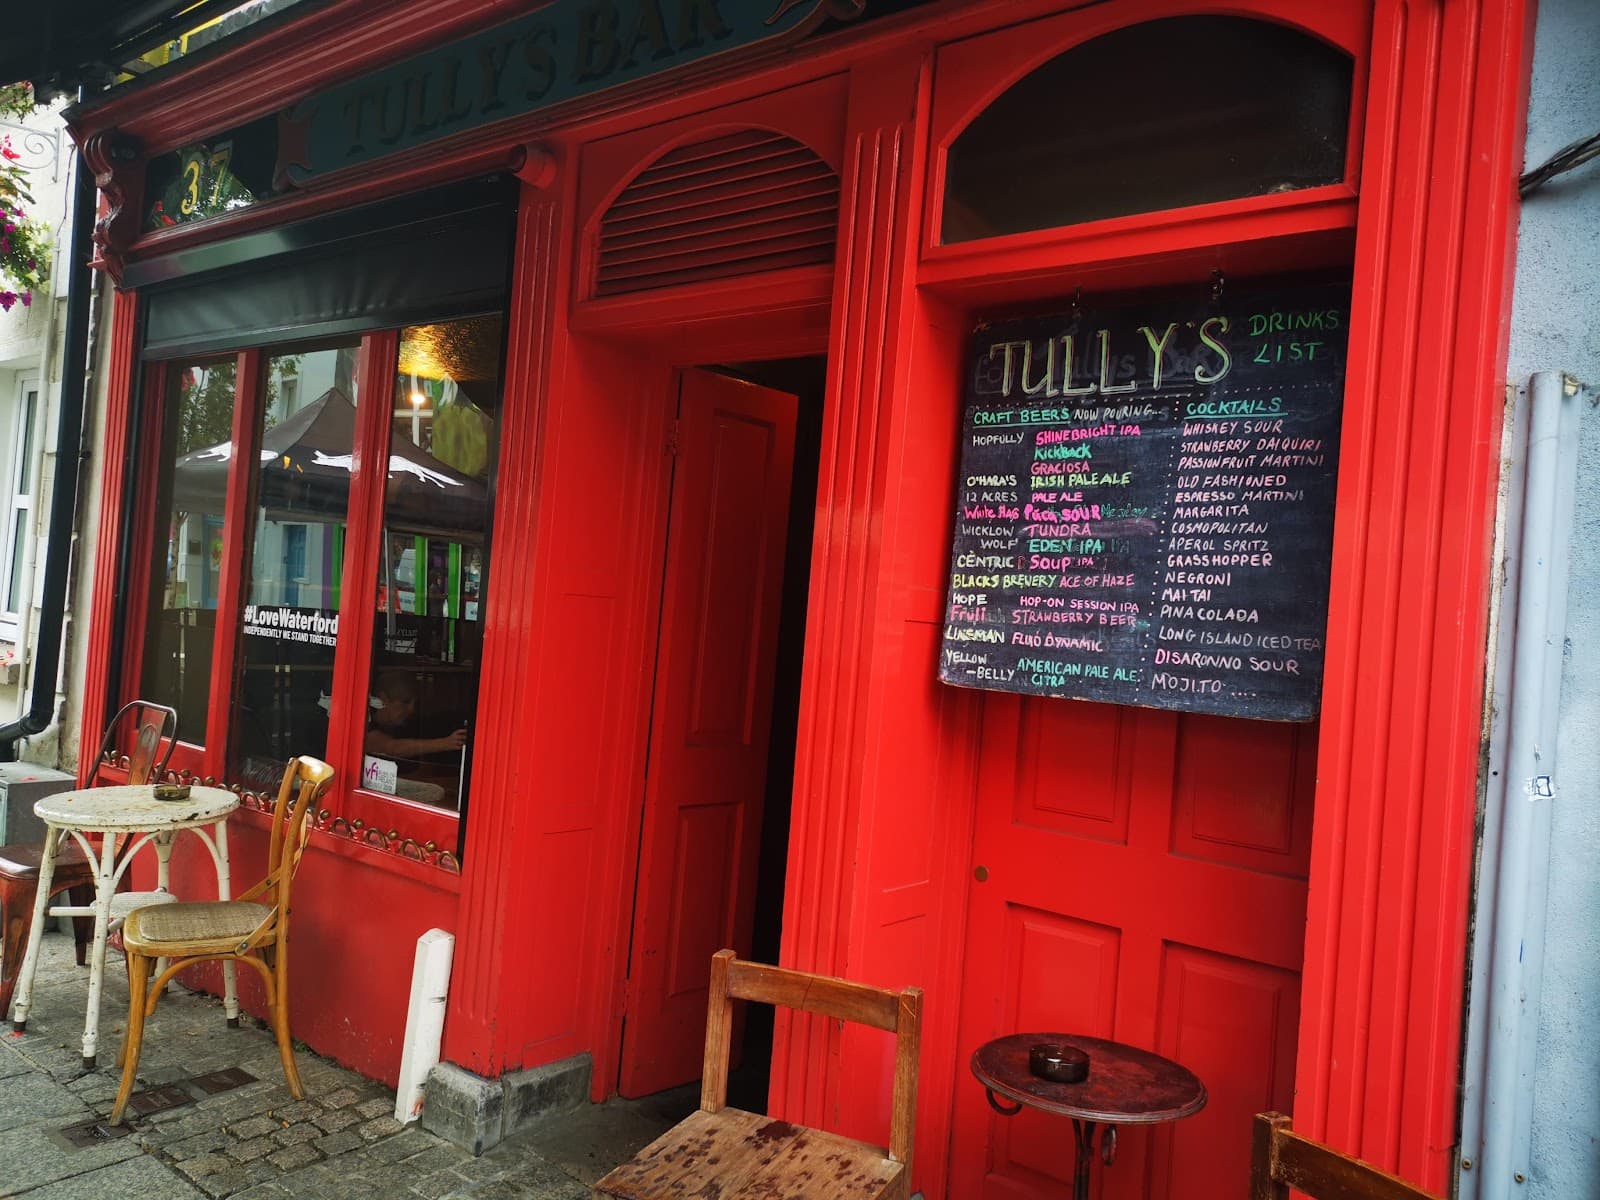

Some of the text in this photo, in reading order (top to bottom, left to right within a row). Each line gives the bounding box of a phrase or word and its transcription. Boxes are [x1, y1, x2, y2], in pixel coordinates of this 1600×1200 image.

[181, 147, 232, 215] 37
[1249, 310, 1339, 336] DRINKS
[990, 316, 1232, 397] TULLY'S
[1253, 342, 1325, 364] LIST
[1187, 397, 1282, 415] COCKTAILS
[973, 411, 1013, 425] CRAFT
[1020, 408, 1070, 423] BEERS
[1073, 408, 1099, 420] NOW
[972, 432, 1024, 446] HOPFULLY
[1120, 425, 1141, 436] IPA
[1183, 419, 1284, 436] WHISKEY SOUR
[1181, 437, 1322, 454] STRAWBERRY DAIQUIRI
[1031, 462, 1090, 475] GRACIOSA
[1260, 453, 1324, 468] MARTINI
[967, 475, 1017, 488] O'HARA'S
[1030, 475, 1065, 490] IRISH
[1177, 474, 1287, 488] OLD FASHIONED
[966, 491, 1083, 503] 12 ACRES PALE ALE
[1175, 491, 1304, 503] ESPRESSO MARTINI
[1062, 505, 1102, 521] SOUR
[1173, 504, 1249, 519] MARGARITA
[962, 523, 1091, 537] WICKLOW TUNDRA
[1171, 522, 1268, 534] COSMOPOLITAN
[1028, 539, 1074, 553] EDEN
[1080, 539, 1102, 553] IPA
[1168, 537, 1269, 552] APEROL SPRITZ
[1077, 557, 1094, 567] IPA
[1167, 553, 1273, 568] GRASSHOPPER
[953, 574, 999, 589] BLACKS
[1059, 575, 1080, 588] ACE
[1084, 575, 1099, 587] OF
[1102, 574, 1135, 587] HAZE
[1165, 571, 1231, 586] NEGRONI
[952, 592, 1140, 614] HOPE HOP-ON SESSION IPA
[1012, 609, 1093, 625] STRAWBERRY
[1099, 609, 1137, 626] BEER
[1160, 604, 1259, 623] PINA COLADA
[243, 625, 337, 647] INDEPENDENTLY WE STAND TOGETHER
[1158, 626, 1322, 651] LONG ISLAND ICED TEA
[946, 649, 1138, 682] YELLOW AMERICAN PALE ALE
[1154, 648, 1300, 675] DISARONNO SOUR
[1031, 673, 1066, 687] CITRA
